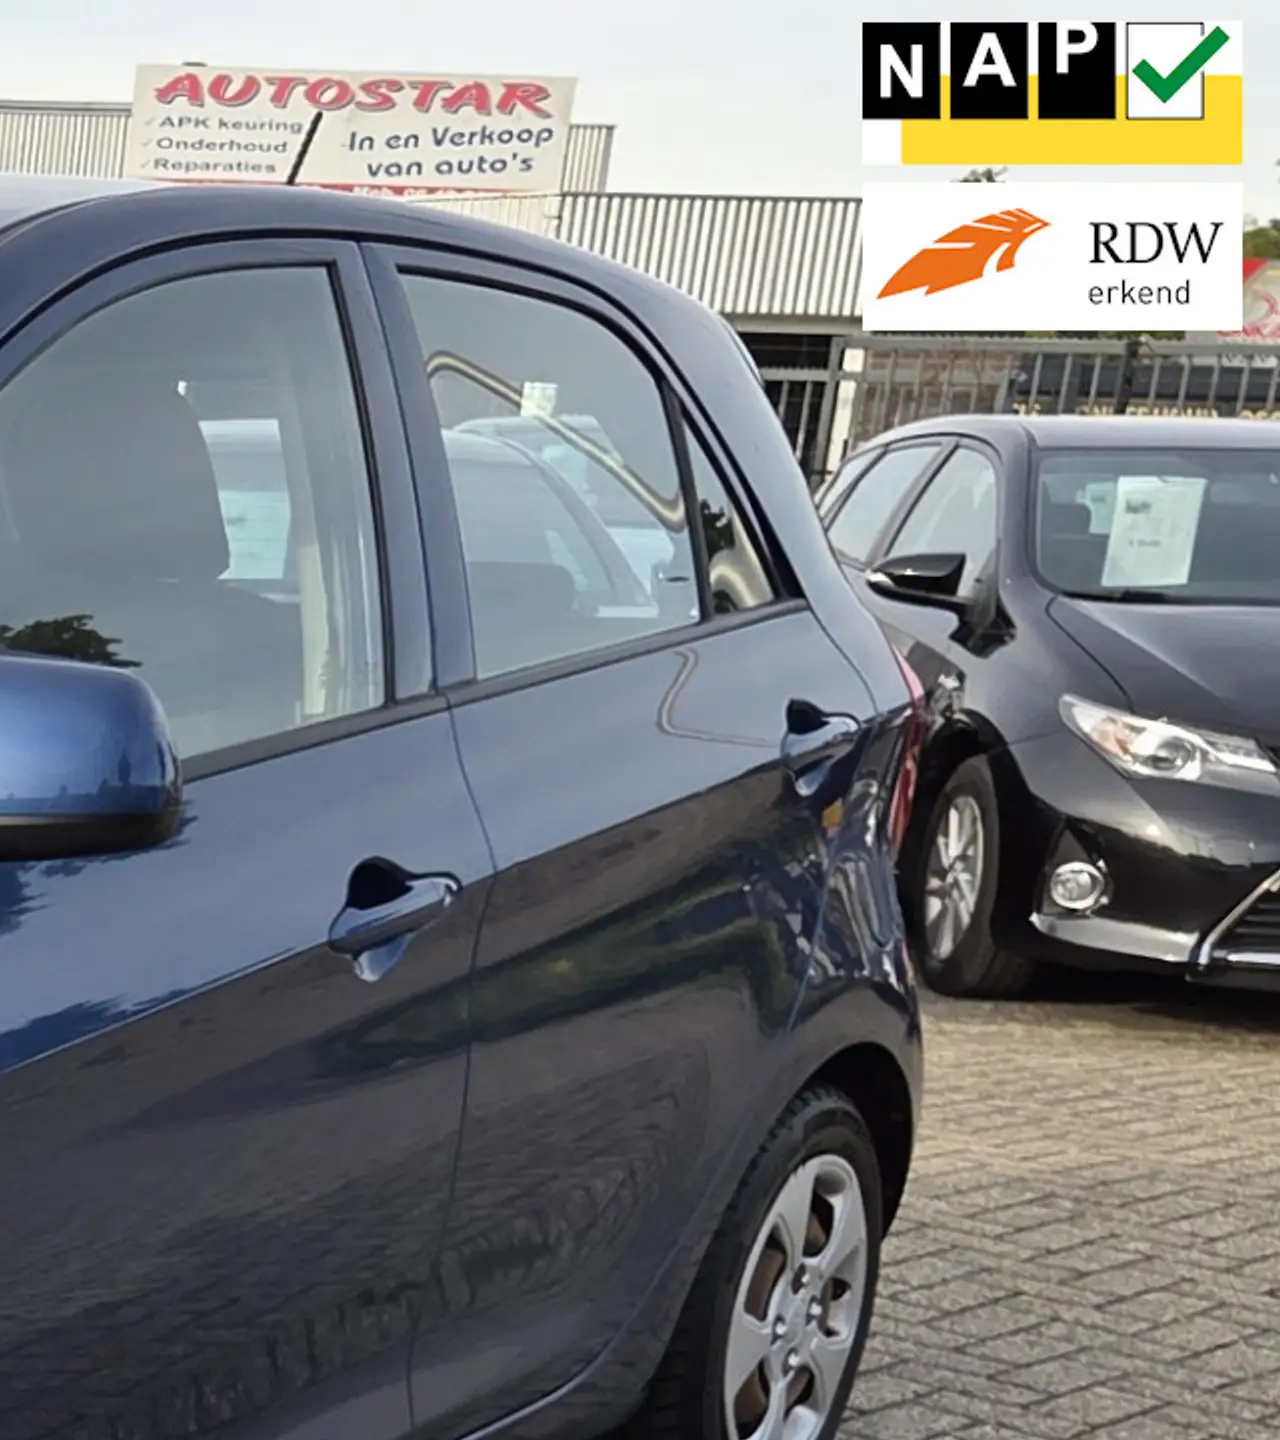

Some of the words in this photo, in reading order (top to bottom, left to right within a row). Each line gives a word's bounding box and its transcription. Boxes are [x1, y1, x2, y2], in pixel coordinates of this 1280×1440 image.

[154, 72, 553, 119] AUTOSTAR
[159, 116, 210, 129] APK
[217, 118, 303, 134] keuring
[155, 136, 288, 153] Onderhoud
[349, 131, 374, 151] In
[385, 132, 419, 149] en
[431, 124, 554, 148] Verkoop
[153, 157, 277, 174] Reparaties
[367, 161, 422, 178] van
[434, 152, 535, 175] auto's
